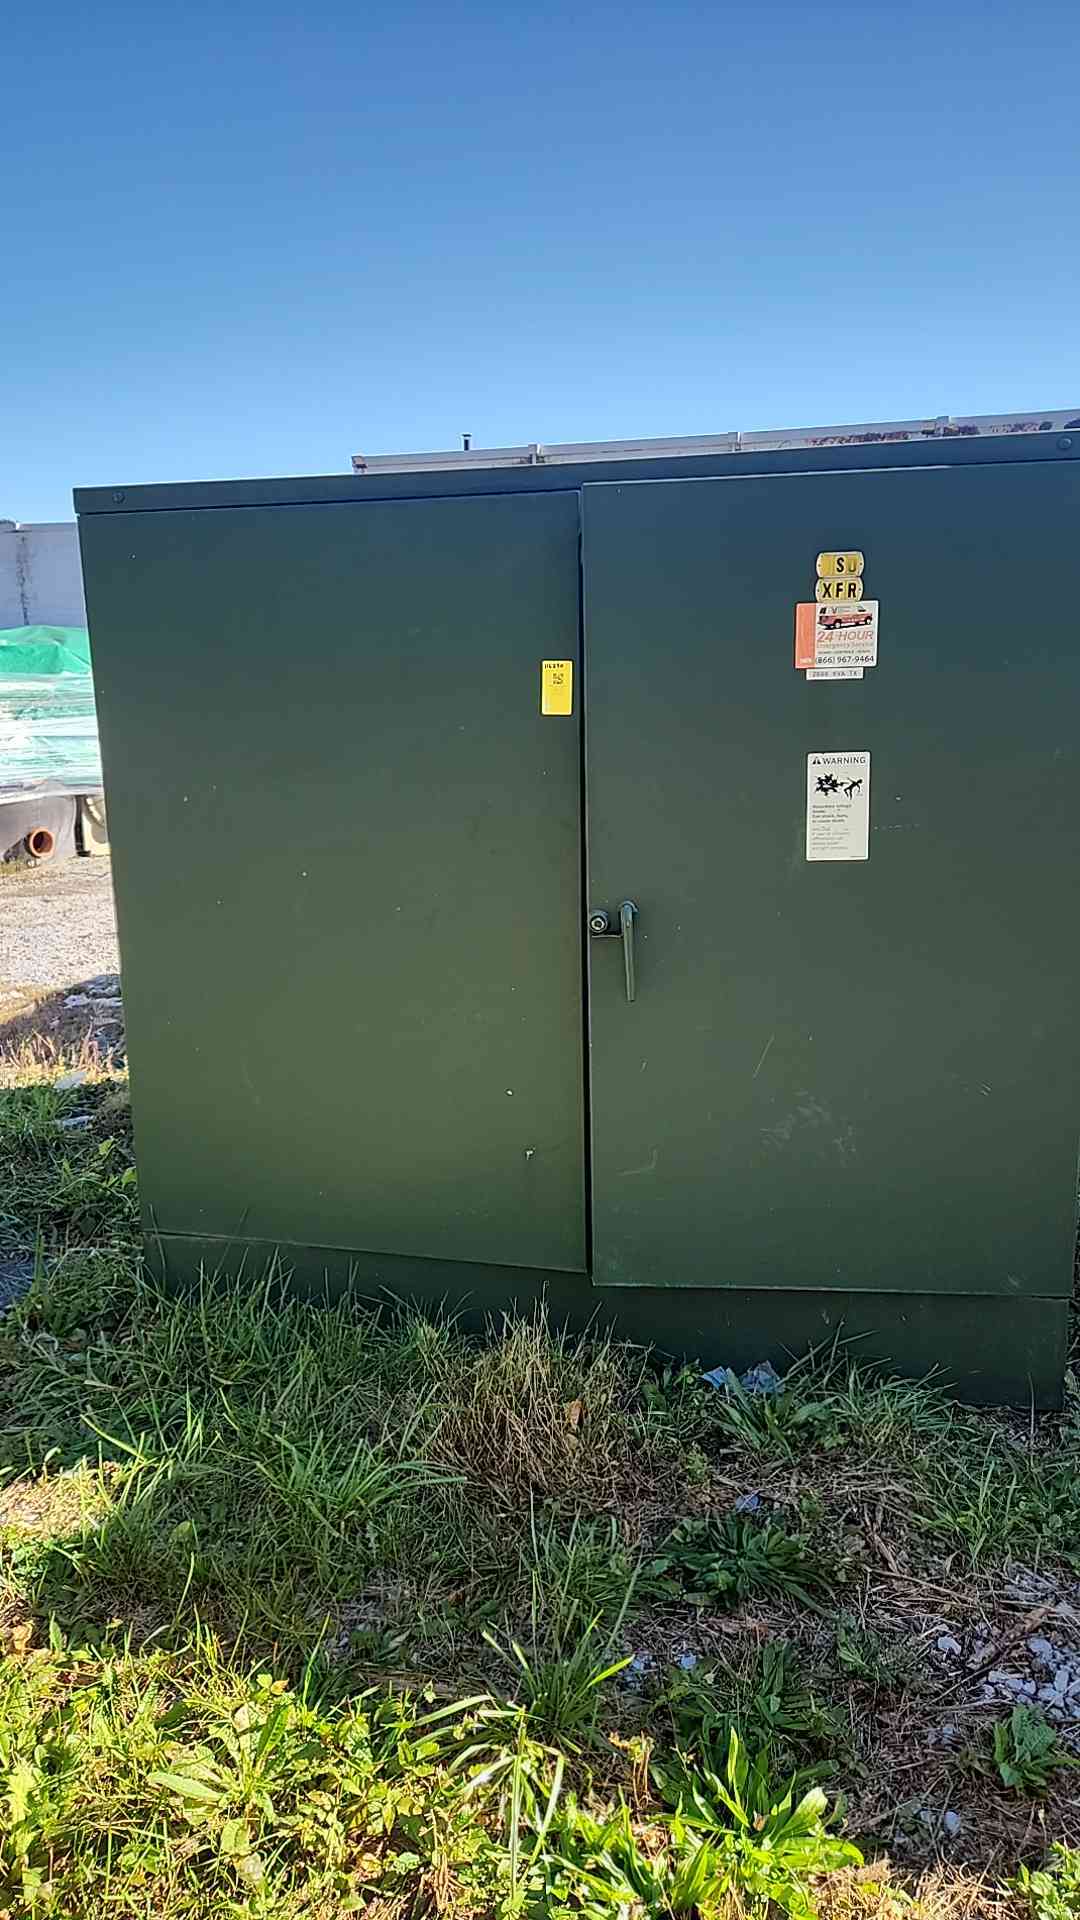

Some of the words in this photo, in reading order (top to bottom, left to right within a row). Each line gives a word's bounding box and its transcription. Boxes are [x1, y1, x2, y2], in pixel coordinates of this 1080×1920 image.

[822, 582, 857, 598] XFR
[817, 631, 833, 640] 24
[836, 630, 873, 640] HOUR
[816, 656, 835, 664] (866)
[837, 655, 874, 663] 967-9464
[822, 756, 866, 765] WARNING
